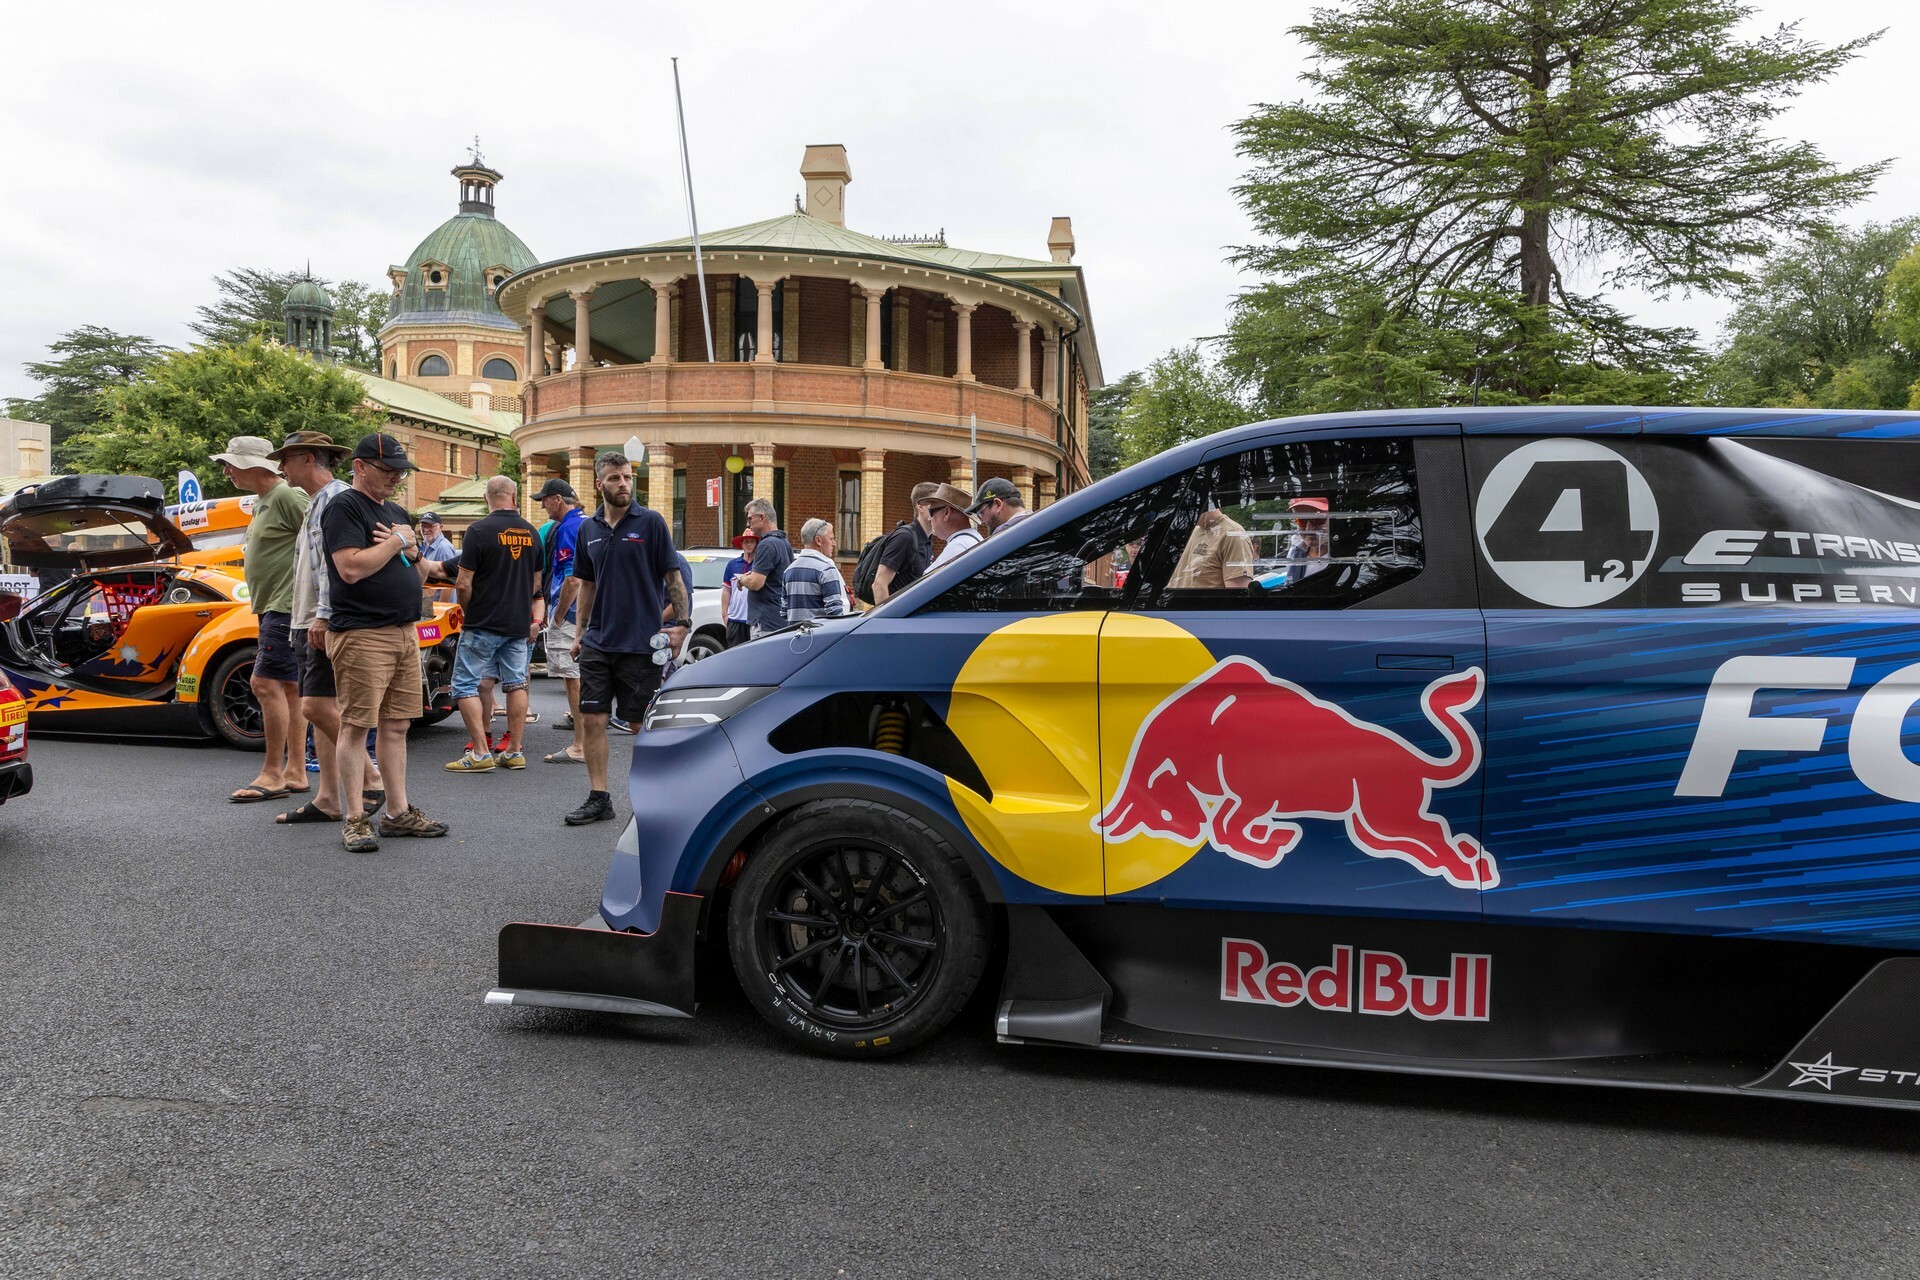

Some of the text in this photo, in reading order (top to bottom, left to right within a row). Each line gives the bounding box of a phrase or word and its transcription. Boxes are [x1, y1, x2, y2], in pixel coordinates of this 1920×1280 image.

[1681, 582, 1916, 603] SUPERV
[422, 628, 436, 638] INV
[1221, 937, 1492, 1021] Red Bull
[825, 1031, 837, 1041] 24
